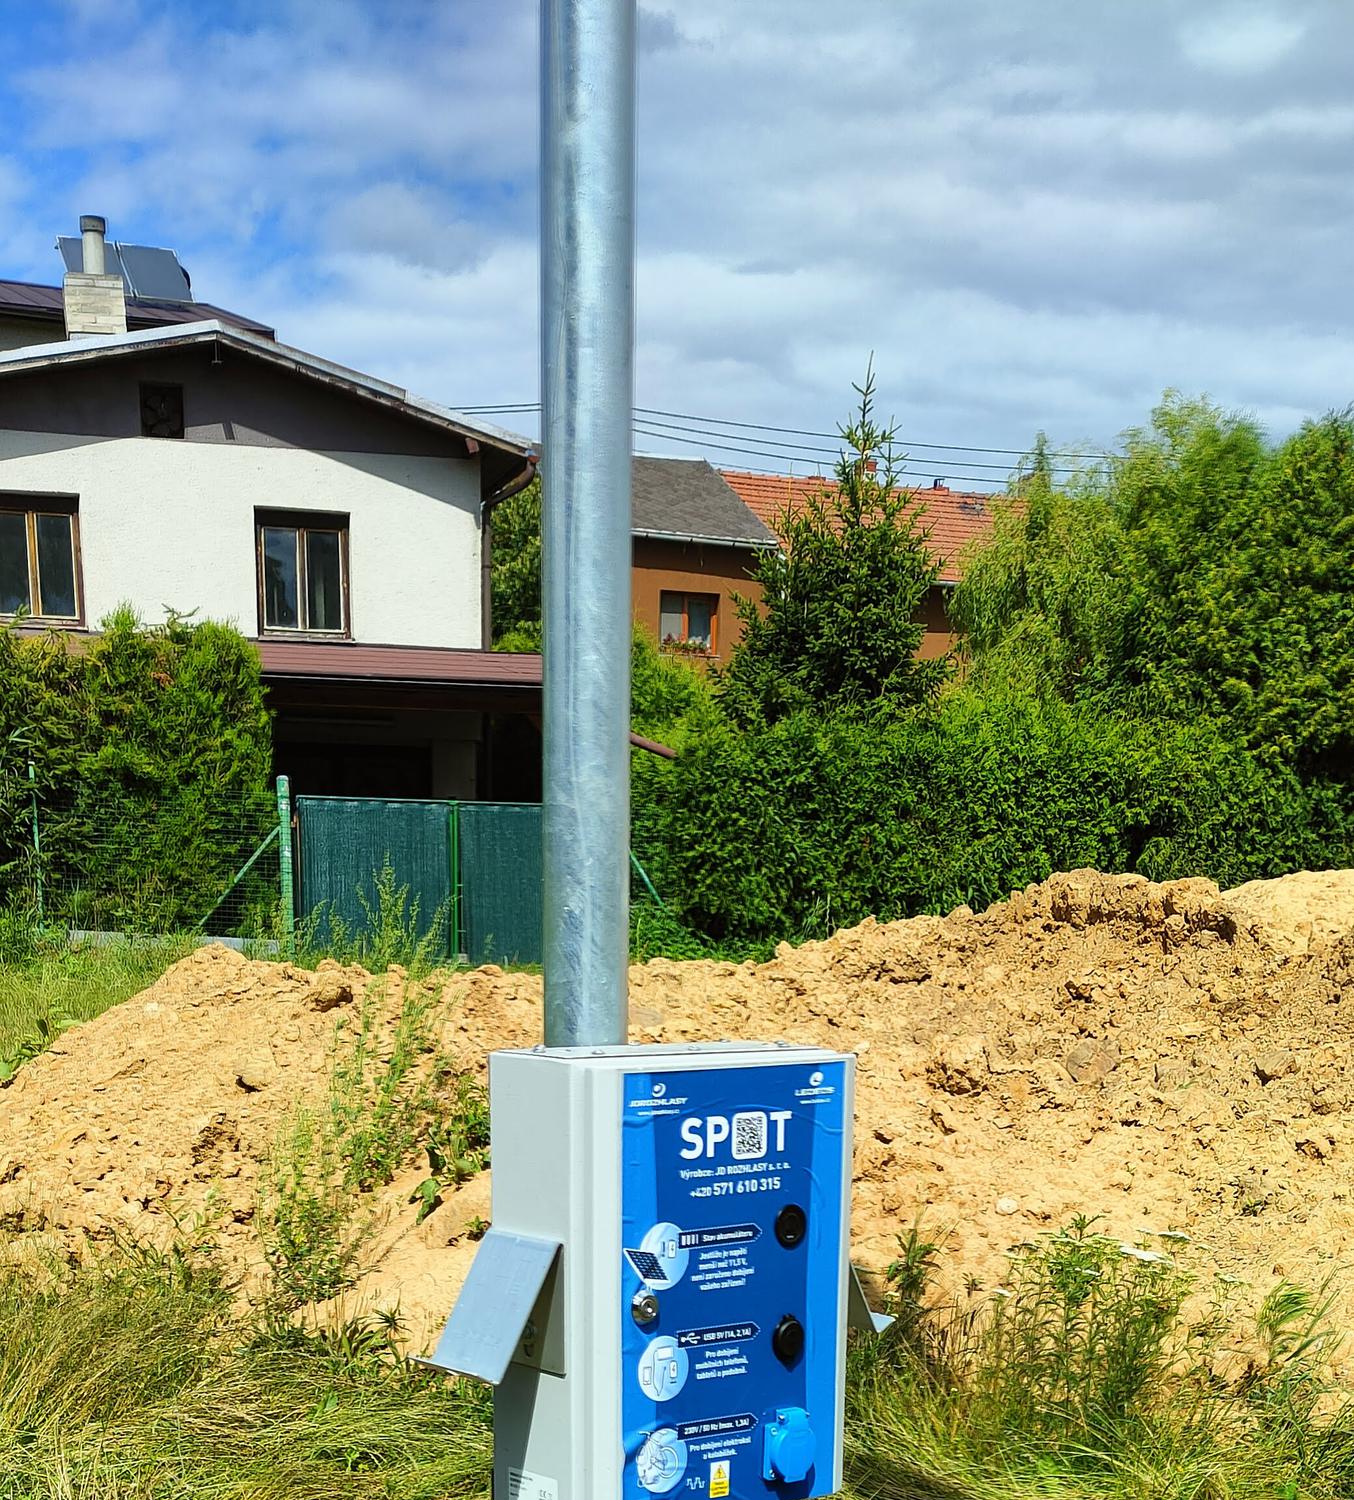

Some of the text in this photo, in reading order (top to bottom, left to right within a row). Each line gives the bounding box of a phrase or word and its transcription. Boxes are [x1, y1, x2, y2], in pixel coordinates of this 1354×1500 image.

[715, 1166, 726, 1176] JD
[727, 1162, 768, 1175] ROZHLASY
[713, 1181, 734, 1196] 571
[736, 1179, 758, 1194] 610
[760, 1177, 781, 1191] 315
[703, 1332, 716, 1341] USB
[703, 1423, 710, 1432] 50
